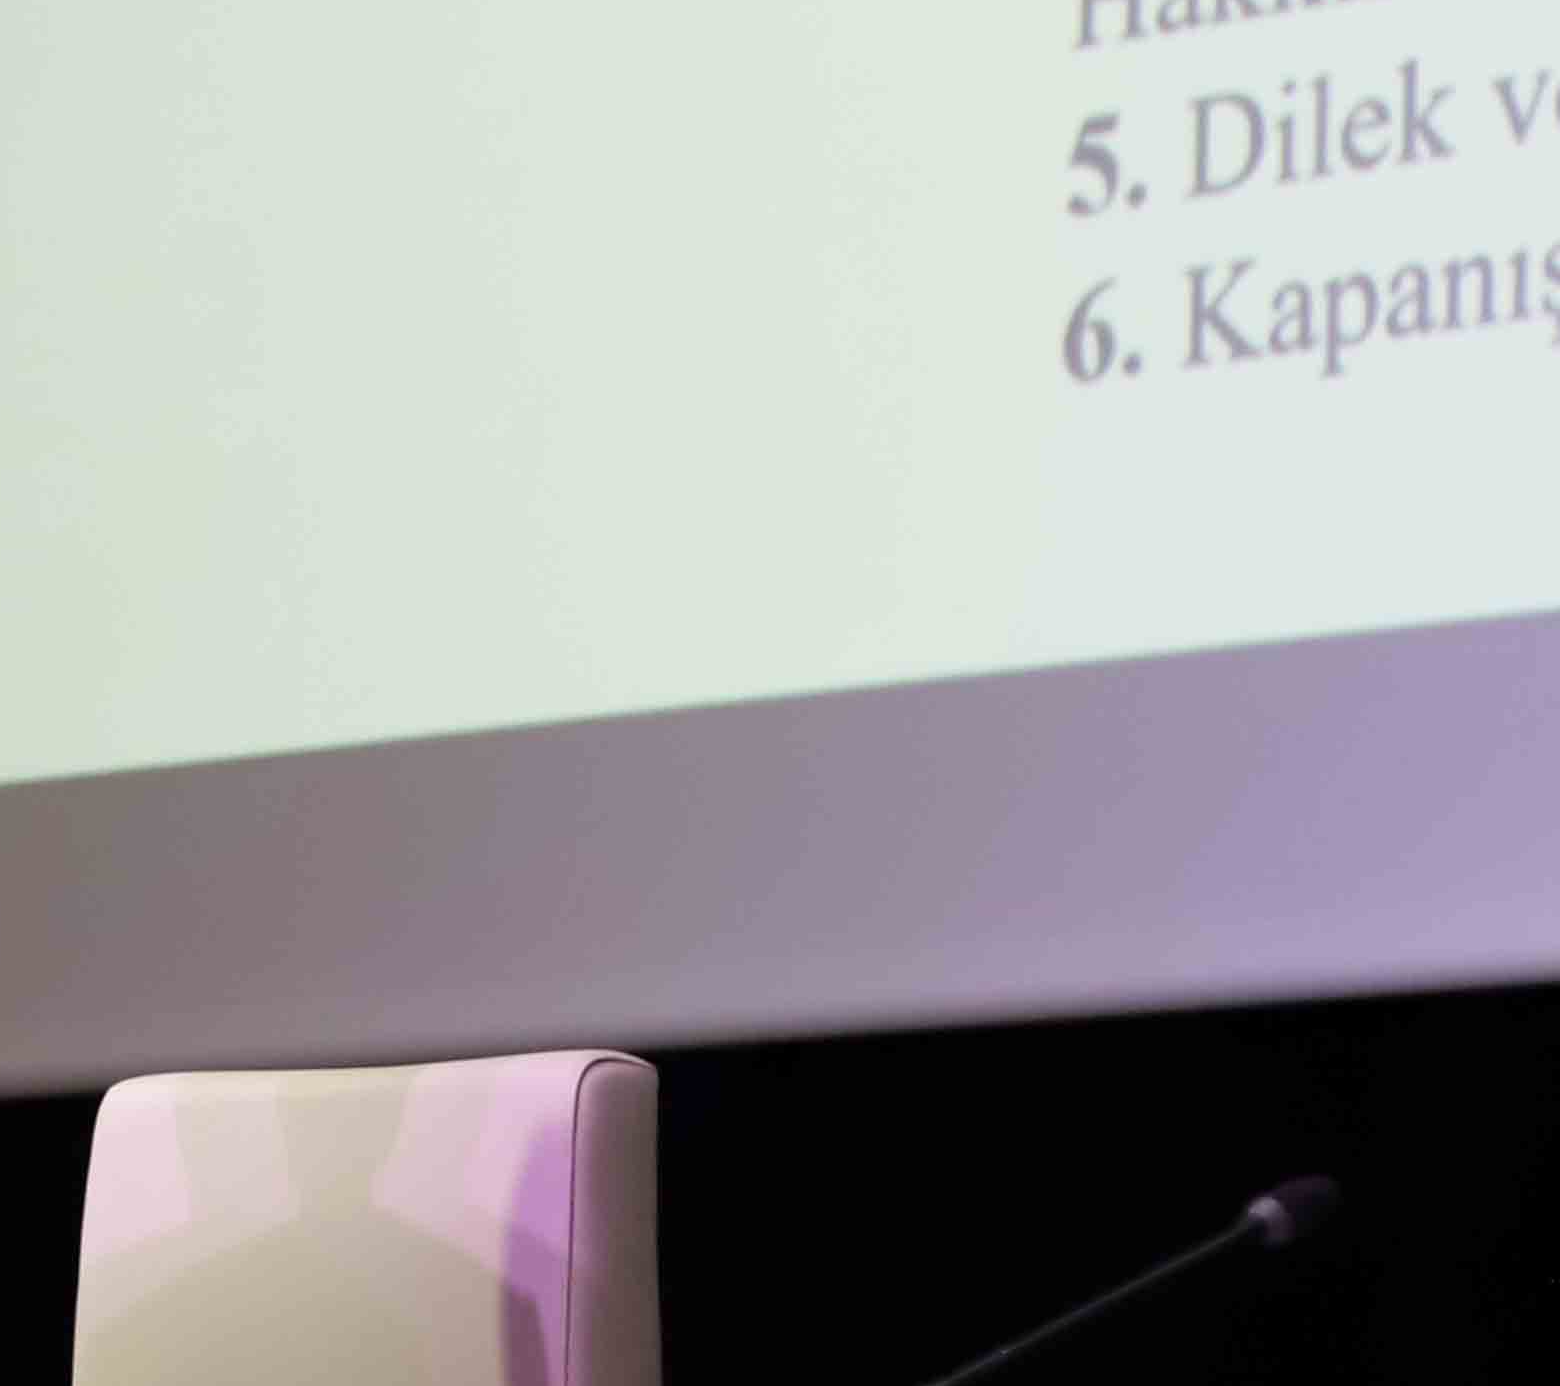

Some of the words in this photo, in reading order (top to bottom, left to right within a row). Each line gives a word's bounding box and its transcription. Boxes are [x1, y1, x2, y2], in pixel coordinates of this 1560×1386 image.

[1066, 111, 1148, 219] 5.
[1186, 57, 1455, 200] Dilek
[1061, 277, 1144, 386] 6.
